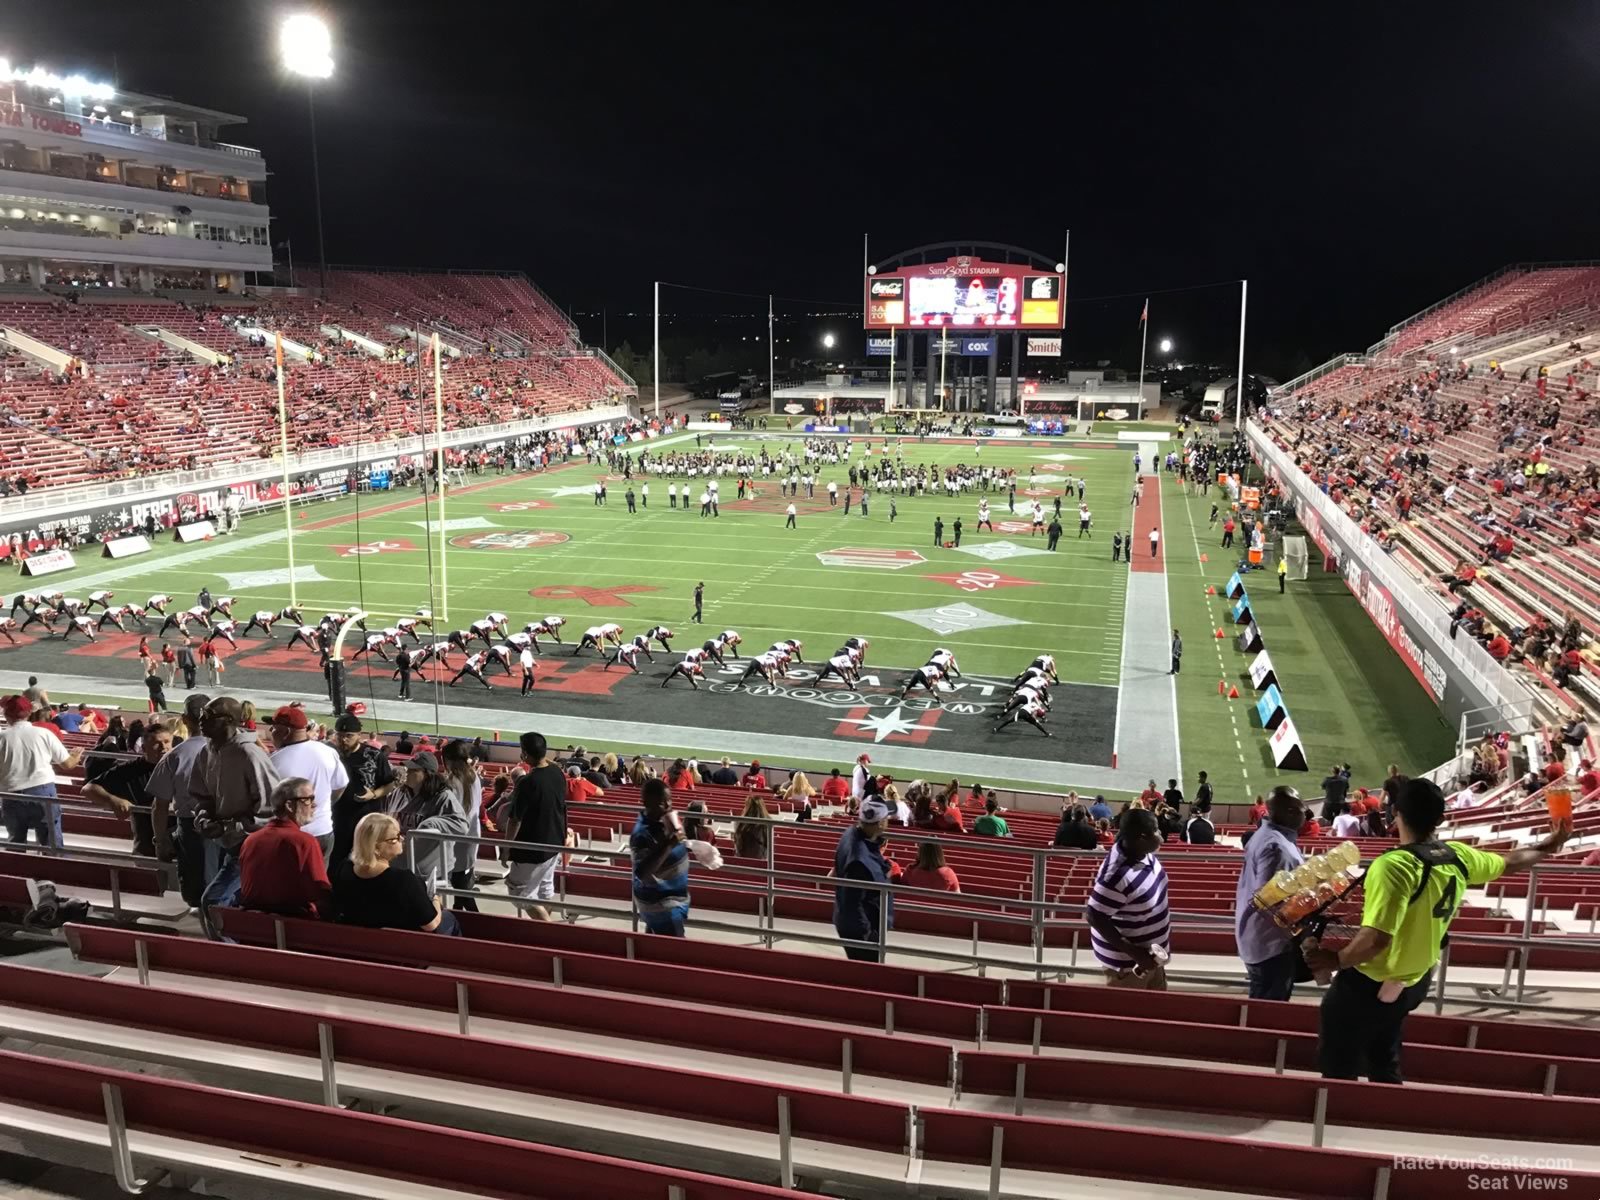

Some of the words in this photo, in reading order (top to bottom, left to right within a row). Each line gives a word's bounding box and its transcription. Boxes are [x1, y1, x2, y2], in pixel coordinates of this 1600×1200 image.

[969, 267, 1000, 275] STADIUM
[1028, 340, 1062, 352] Smith's
[955, 571, 1001, 588] 20
[930, 608, 979, 628] 10
[1433, 875, 1457, 919] 4
